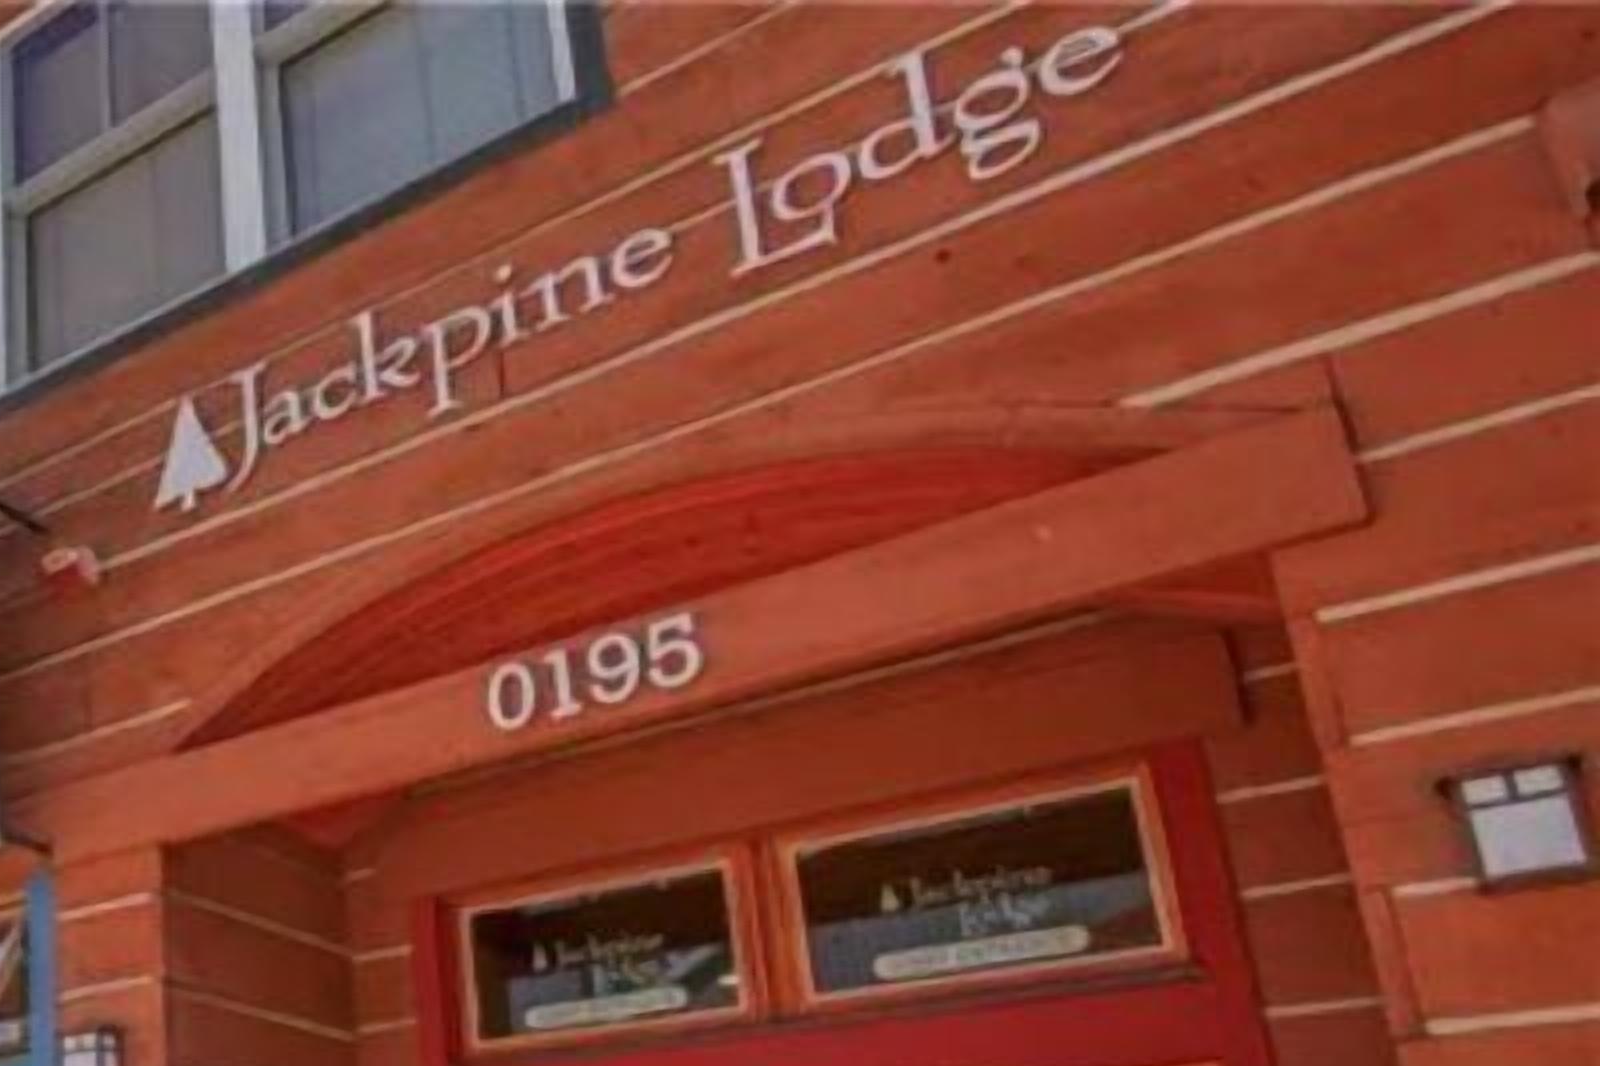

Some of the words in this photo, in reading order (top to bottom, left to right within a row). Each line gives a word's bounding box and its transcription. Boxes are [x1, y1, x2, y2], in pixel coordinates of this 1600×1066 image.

[226, 225, 674, 492] Jackpine
[714, 24, 1122, 278] Lodge
[488, 612, 704, 732] 0195
